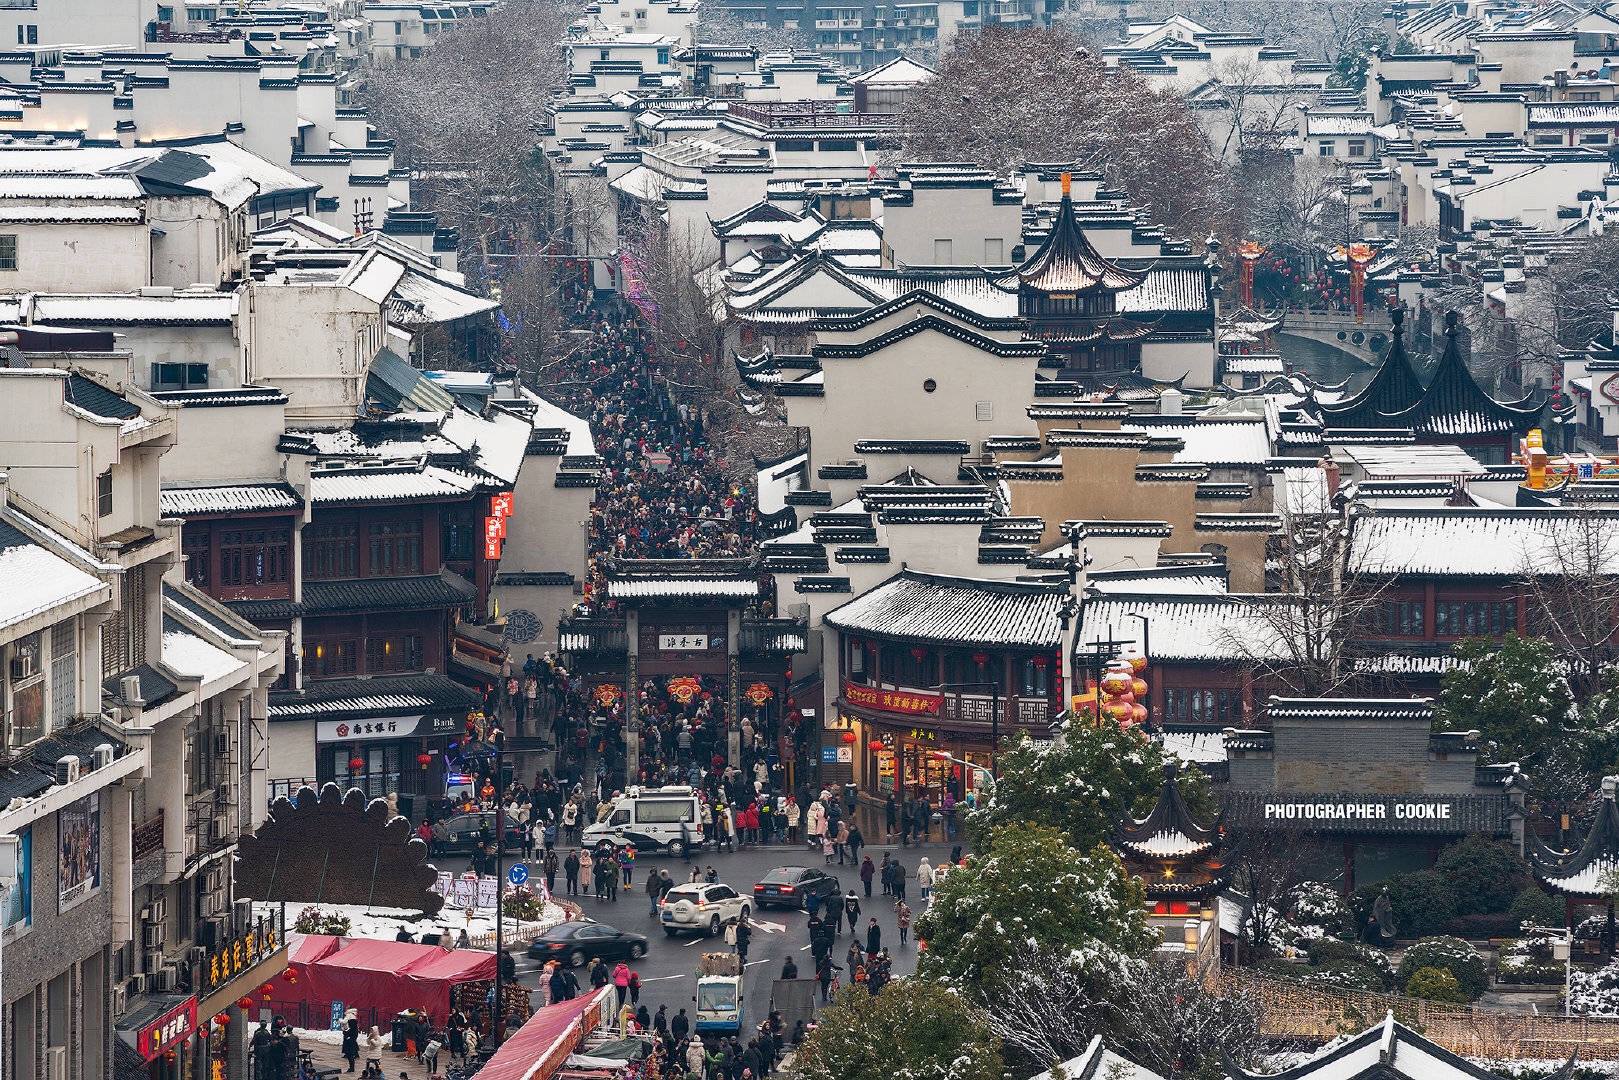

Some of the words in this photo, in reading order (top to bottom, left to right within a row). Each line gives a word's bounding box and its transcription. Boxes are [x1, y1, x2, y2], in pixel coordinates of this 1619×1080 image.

[353, 721, 397, 735] 南京银行
[433, 717, 455, 727] Bank
